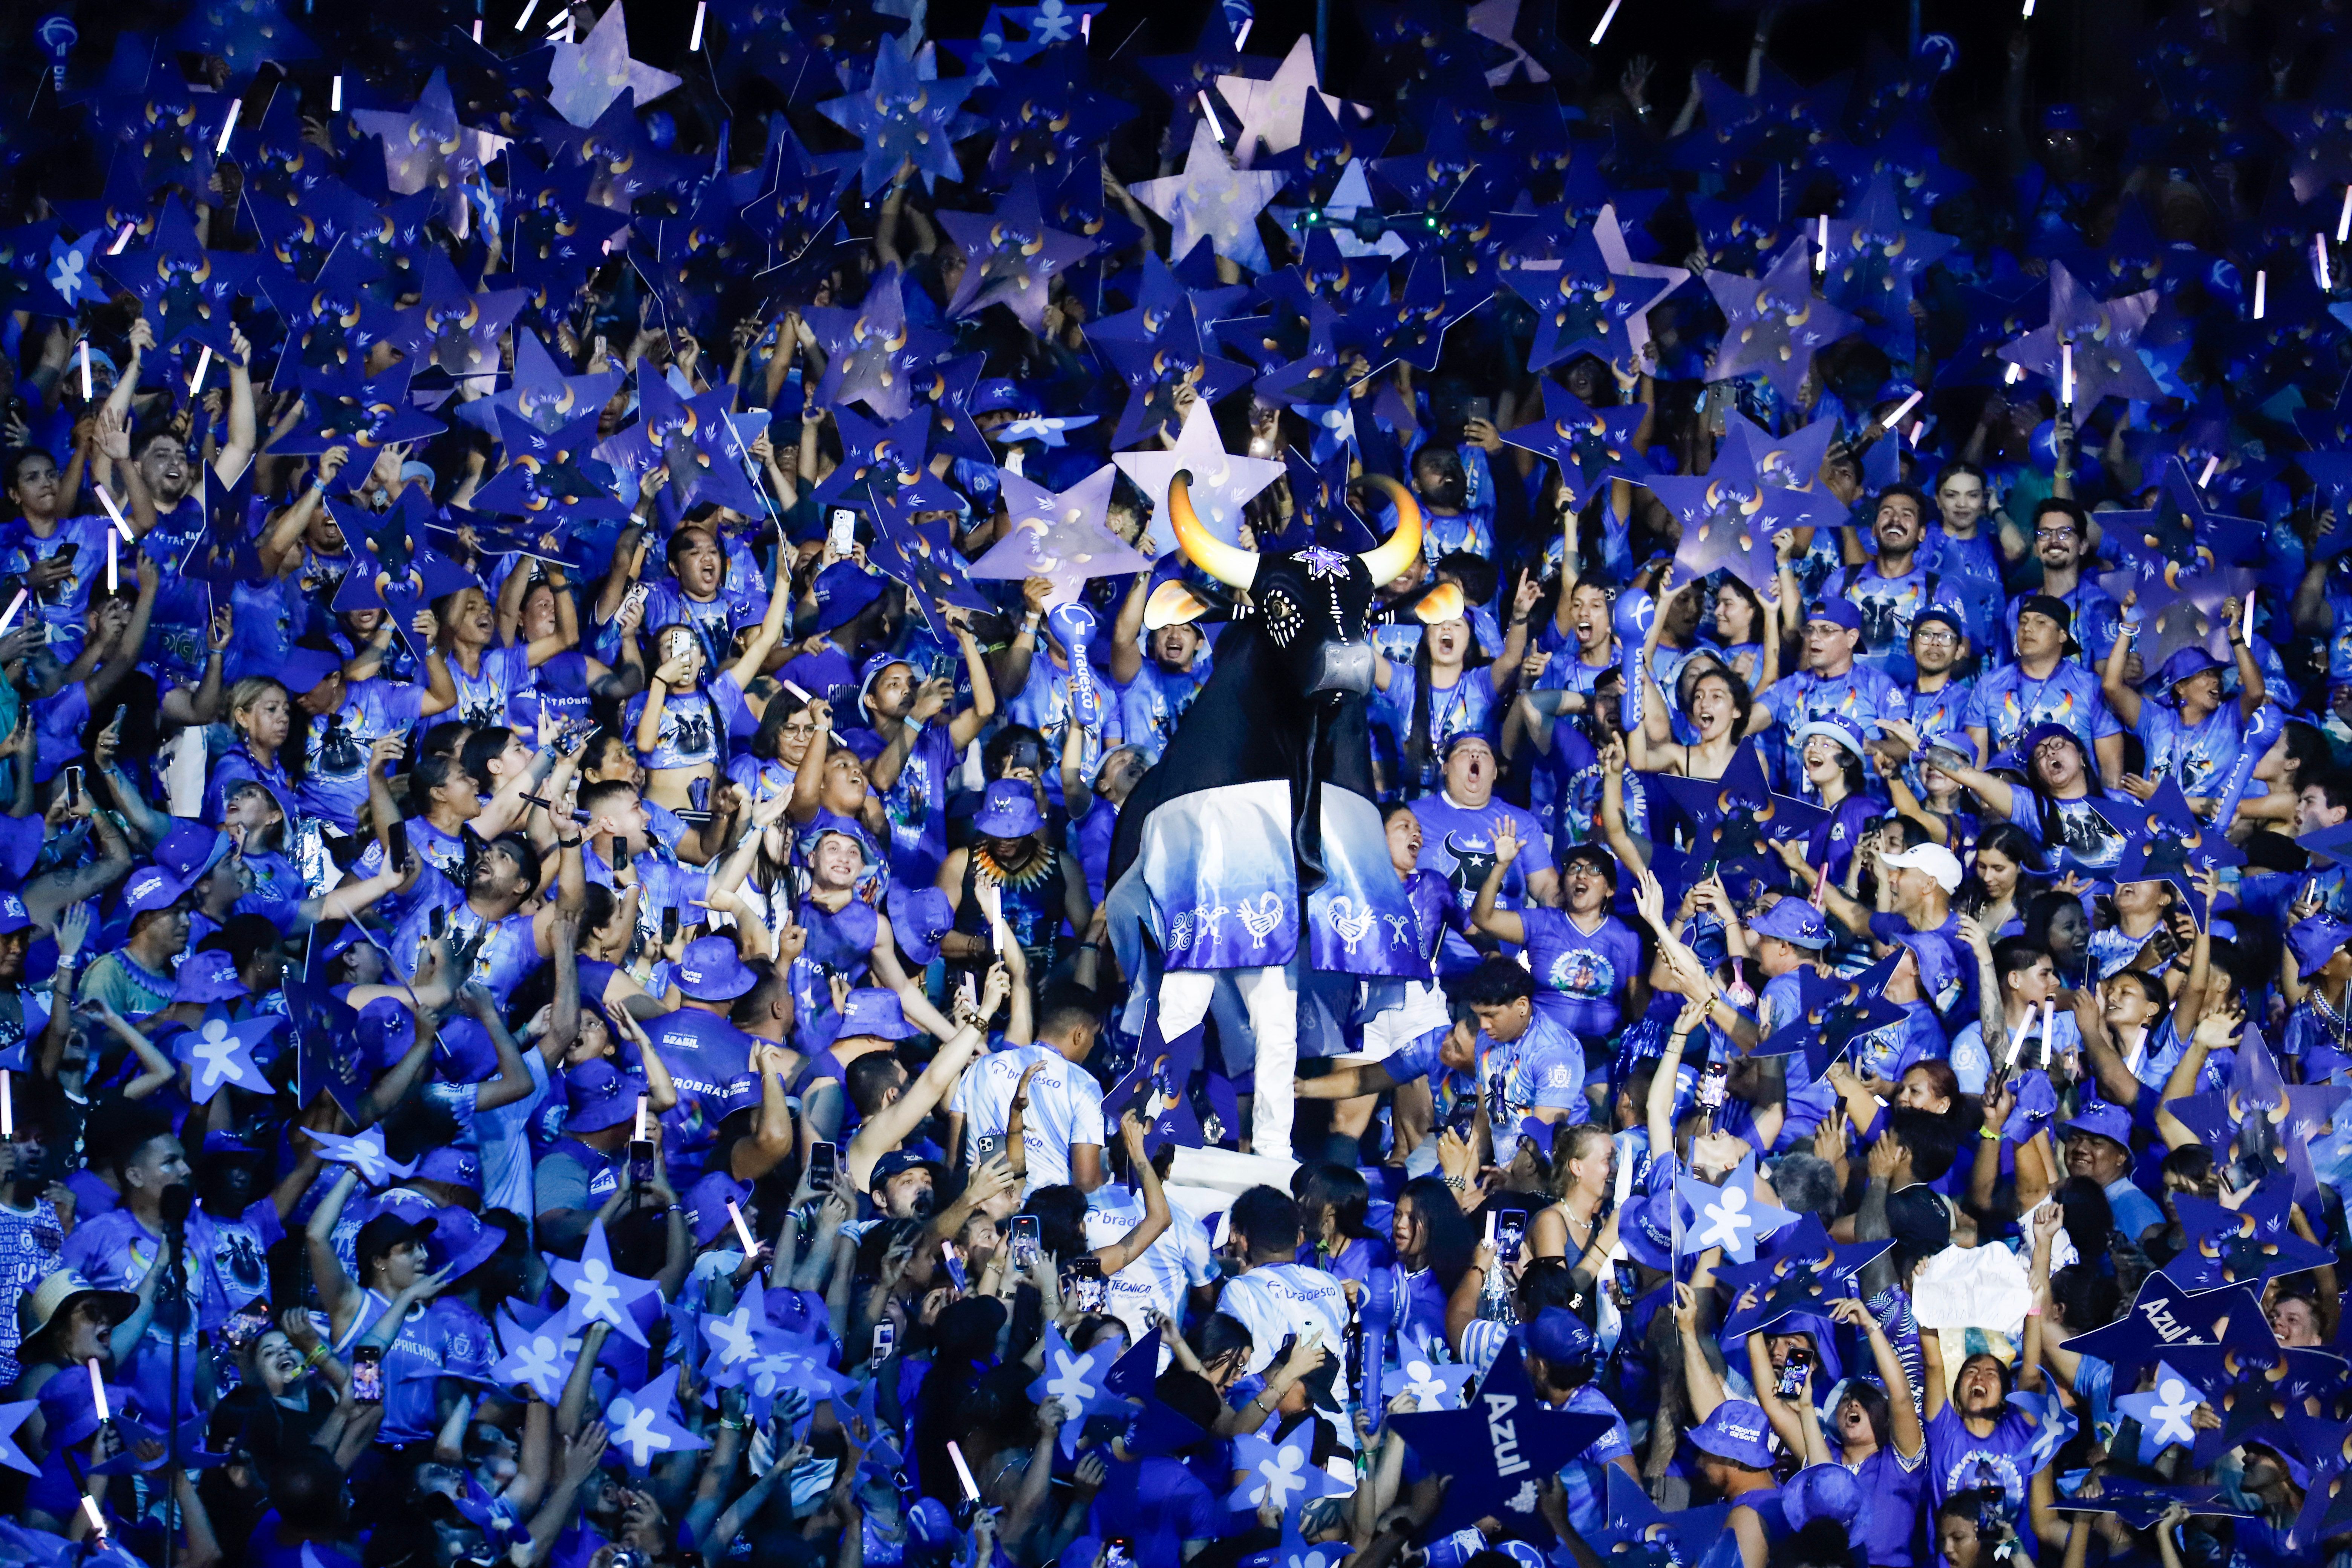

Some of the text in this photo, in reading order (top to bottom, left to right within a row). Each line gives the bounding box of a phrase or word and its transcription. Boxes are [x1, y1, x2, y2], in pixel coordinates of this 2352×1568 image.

[1074, 644, 1094, 709] bradesco
[662, 1034, 699, 1049] BRASIL
[671, 1077, 729, 1099] ROBRAS
[1007, 1068, 1061, 1089] bresco
[2139, 1297, 2191, 1343] Azul
[1484, 1393, 1531, 1477] Azul
[1729, 1424, 1761, 1437] esportes
